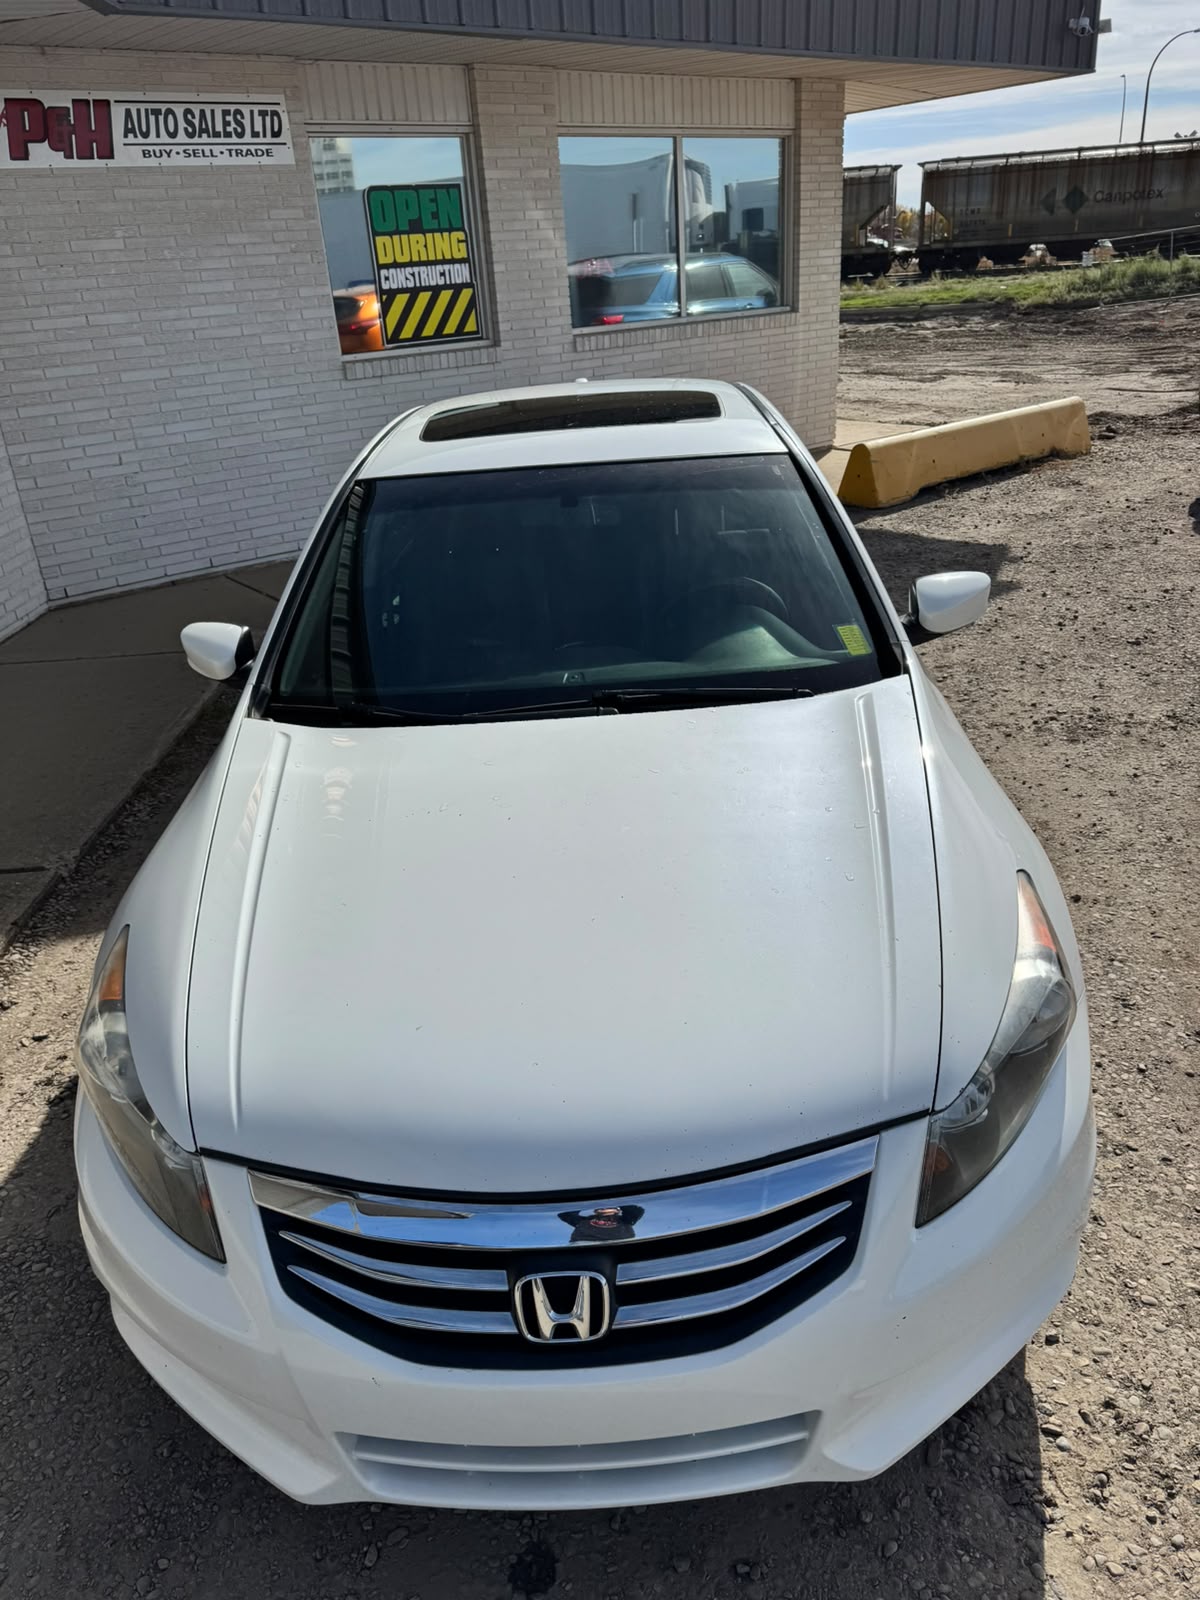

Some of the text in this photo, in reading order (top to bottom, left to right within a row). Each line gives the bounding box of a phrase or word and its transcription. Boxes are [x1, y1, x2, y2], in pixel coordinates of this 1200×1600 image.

[123, 107, 283, 139] AUTO SALES LTD
[369, 188, 463, 232] OPEN
[1094, 188, 1164, 205] Canpotex
[375, 231, 468, 264] DURING
[380, 263, 470, 290] CONSTRUCTION
